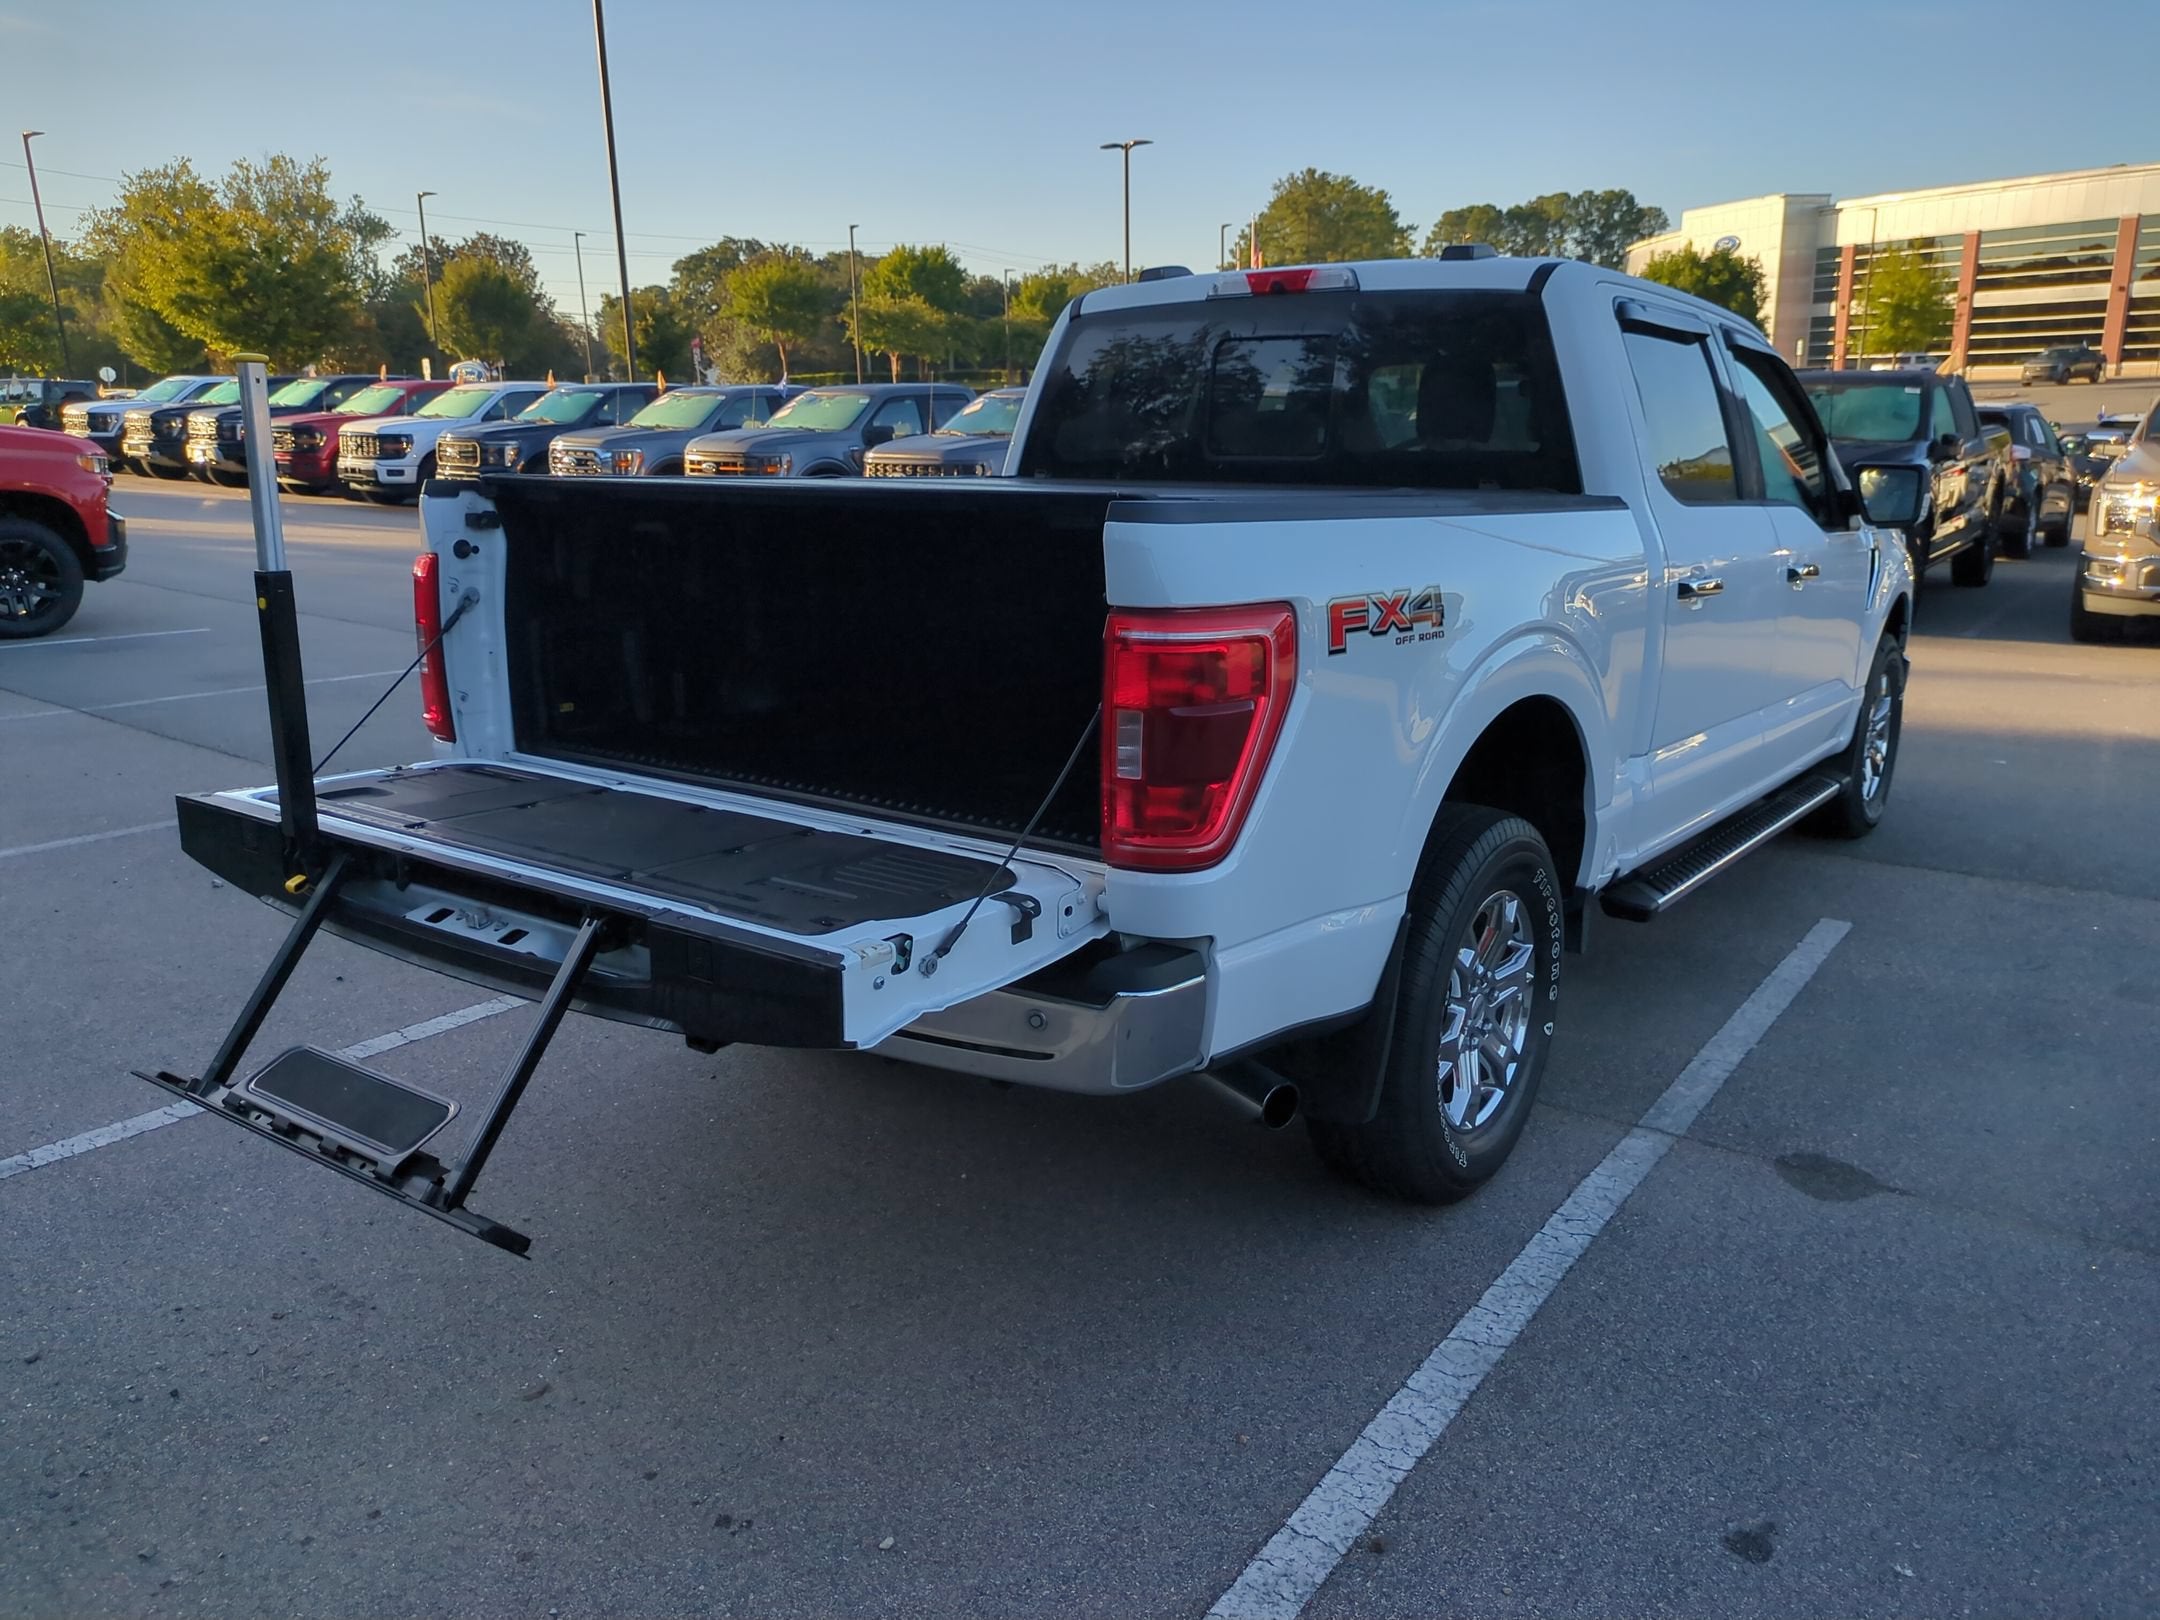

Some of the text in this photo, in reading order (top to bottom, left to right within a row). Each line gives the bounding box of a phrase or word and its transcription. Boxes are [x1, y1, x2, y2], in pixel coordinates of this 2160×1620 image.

[1327, 584, 1444, 657] FX4
[1395, 630, 1445, 646] OFF ROAD
